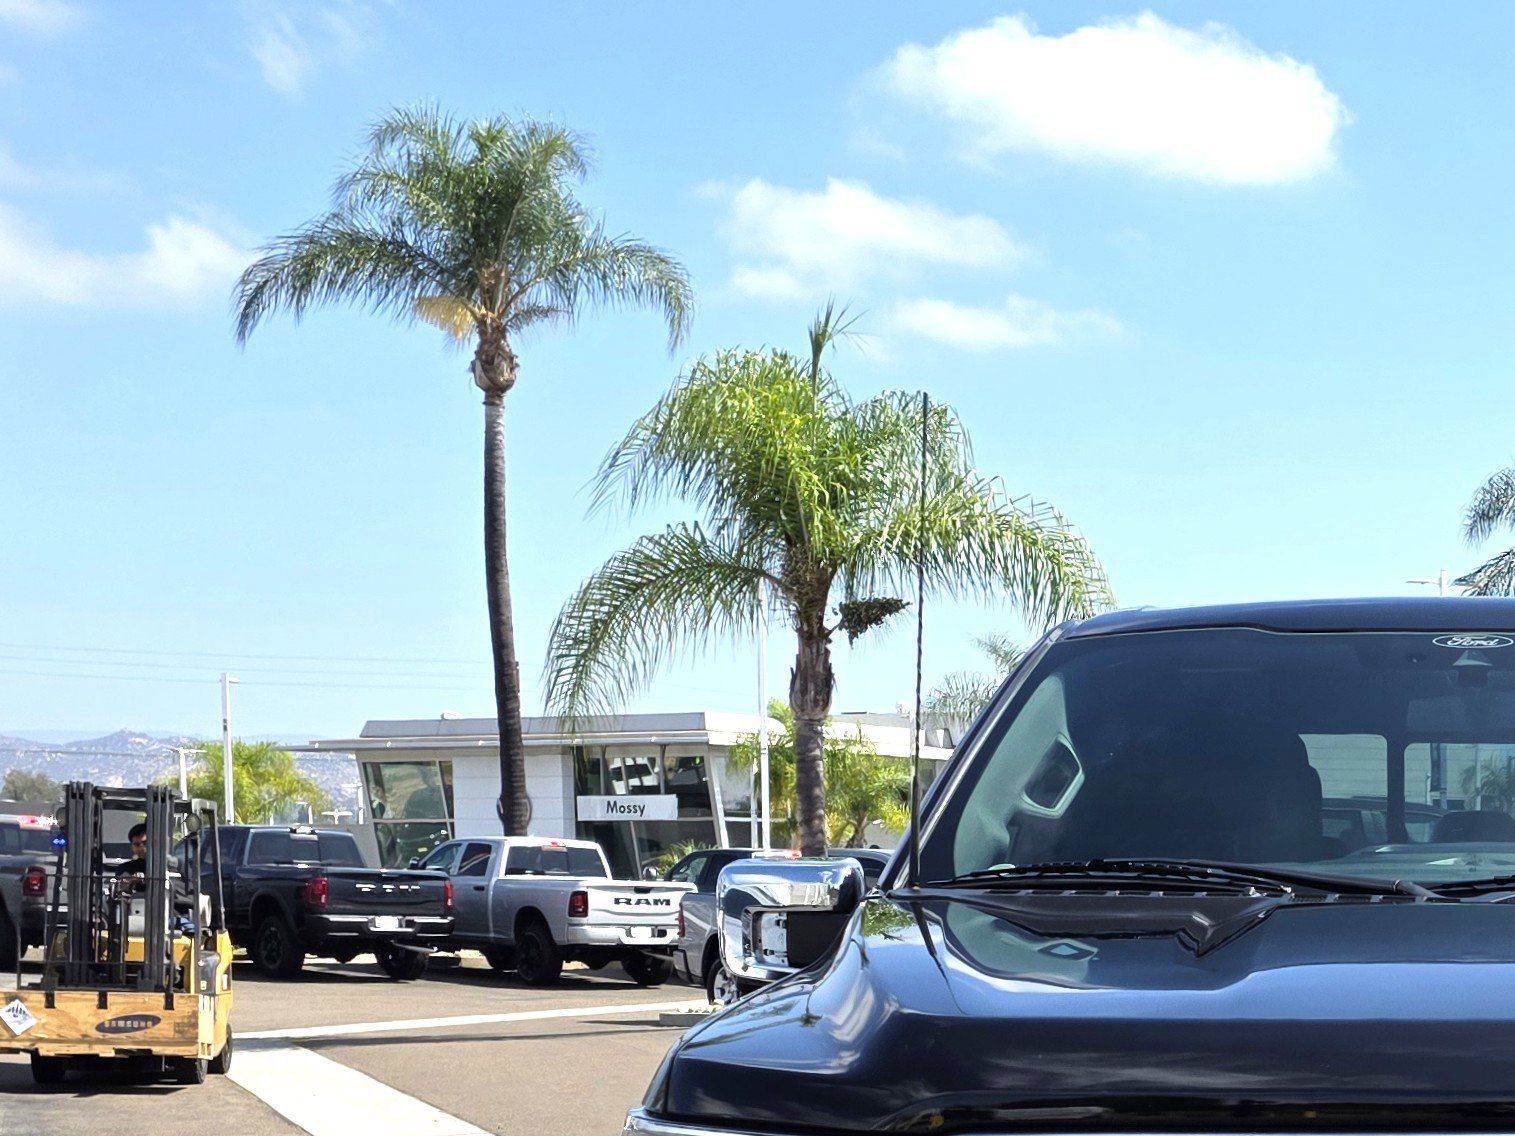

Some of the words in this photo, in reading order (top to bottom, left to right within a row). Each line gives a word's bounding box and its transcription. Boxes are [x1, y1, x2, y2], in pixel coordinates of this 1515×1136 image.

[1446, 636, 1498, 647] Ford
[606, 800, 646, 817] Mossy
[613, 897, 671, 906] RAM
